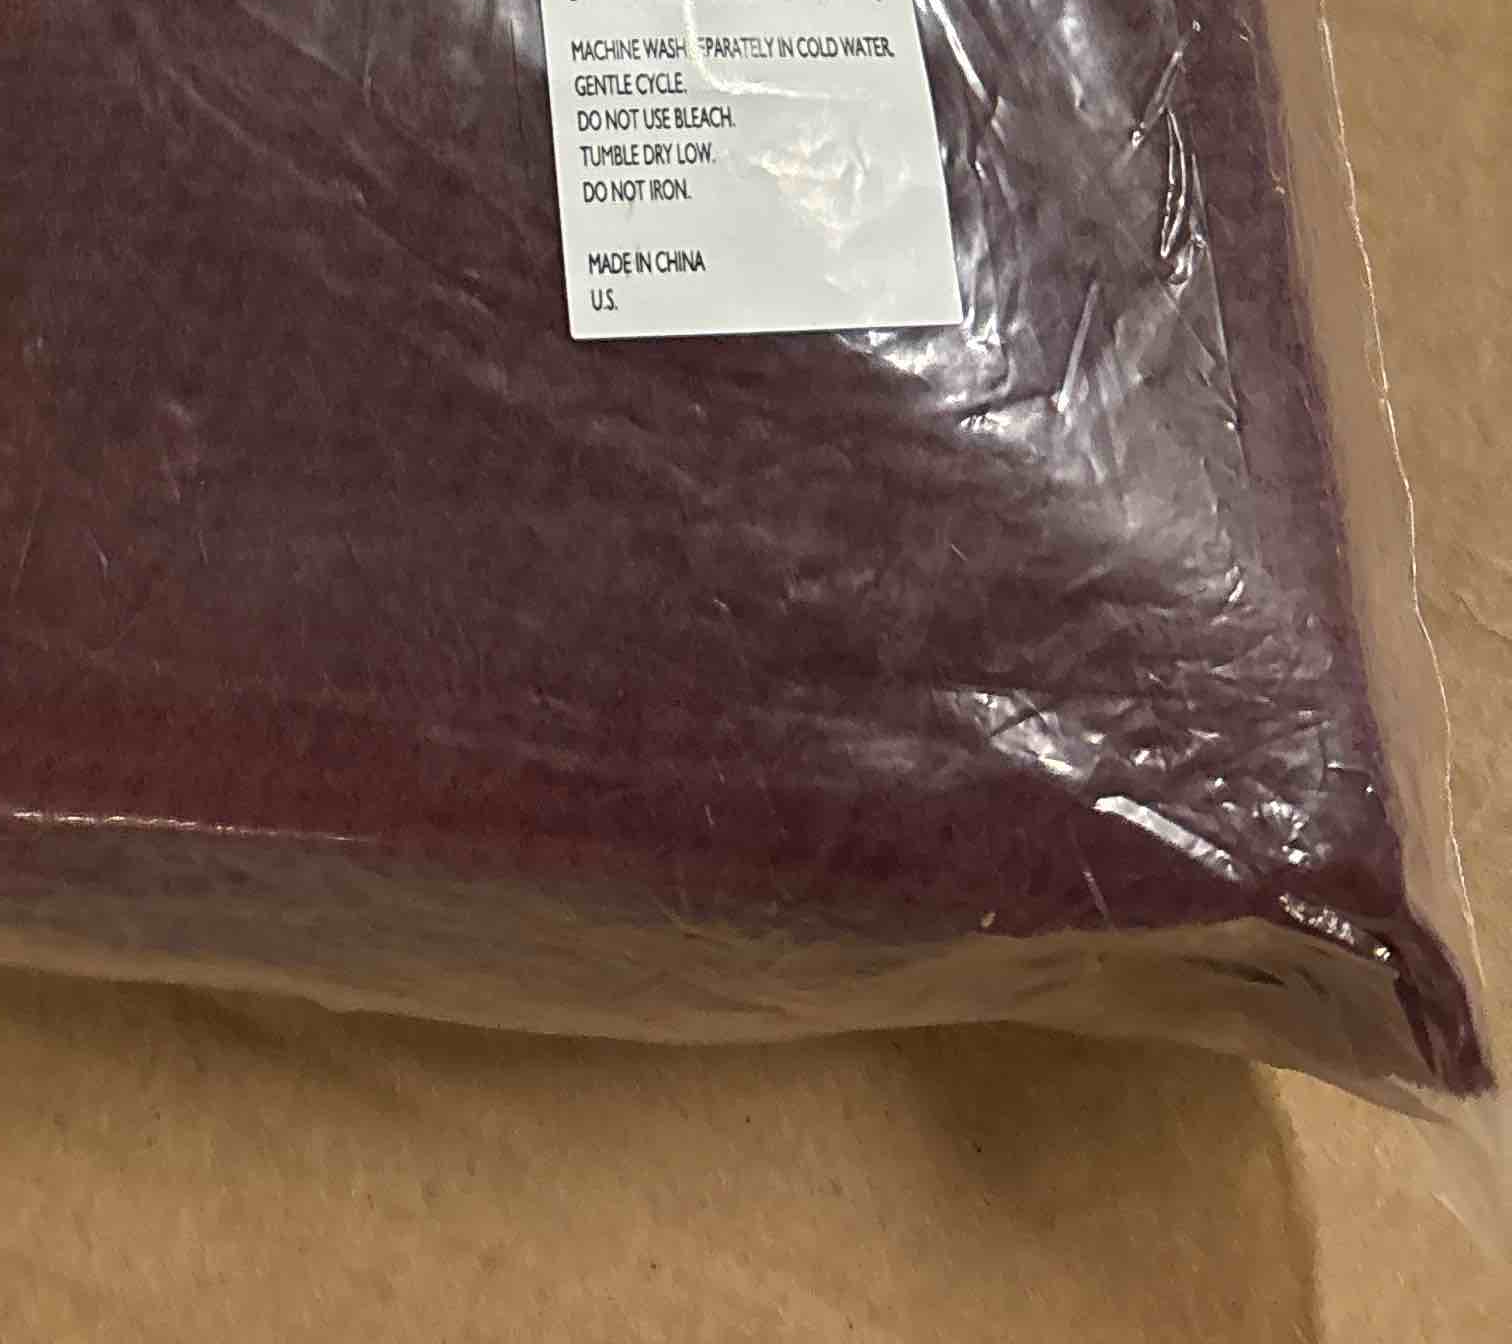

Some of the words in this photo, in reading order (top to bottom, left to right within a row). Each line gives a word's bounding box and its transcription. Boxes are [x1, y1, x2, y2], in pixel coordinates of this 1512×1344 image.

[571, 39, 641, 62] MACHINE
[642, 38, 687, 60] WASH
[692, 37, 774, 59] EPARATELY
[777, 37, 794, 59] IN
[796, 36, 838, 59] COLD
[574, 72, 633, 97] GENTLE
[634, 71, 688, 96] CYCLE.
[577, 109, 602, 133] DO
[605, 108, 640, 131] NOT
[643, 107, 671, 130] USE
[674, 106, 736, 130] BLEACH.
[579, 144, 640, 168] TUMBLE
[642, 143, 673, 166] DRY
[676, 141, 716, 165] LOW.
[583, 180, 608, 204] DO
[610, 179, 647, 202] NOT
[649, 178, 692, 201] IRON.
[588, 251, 633, 275] MADE
[635, 251, 652, 274] IN
[655, 250, 706, 273] CHINA
[590, 288, 619, 311] U.S.
